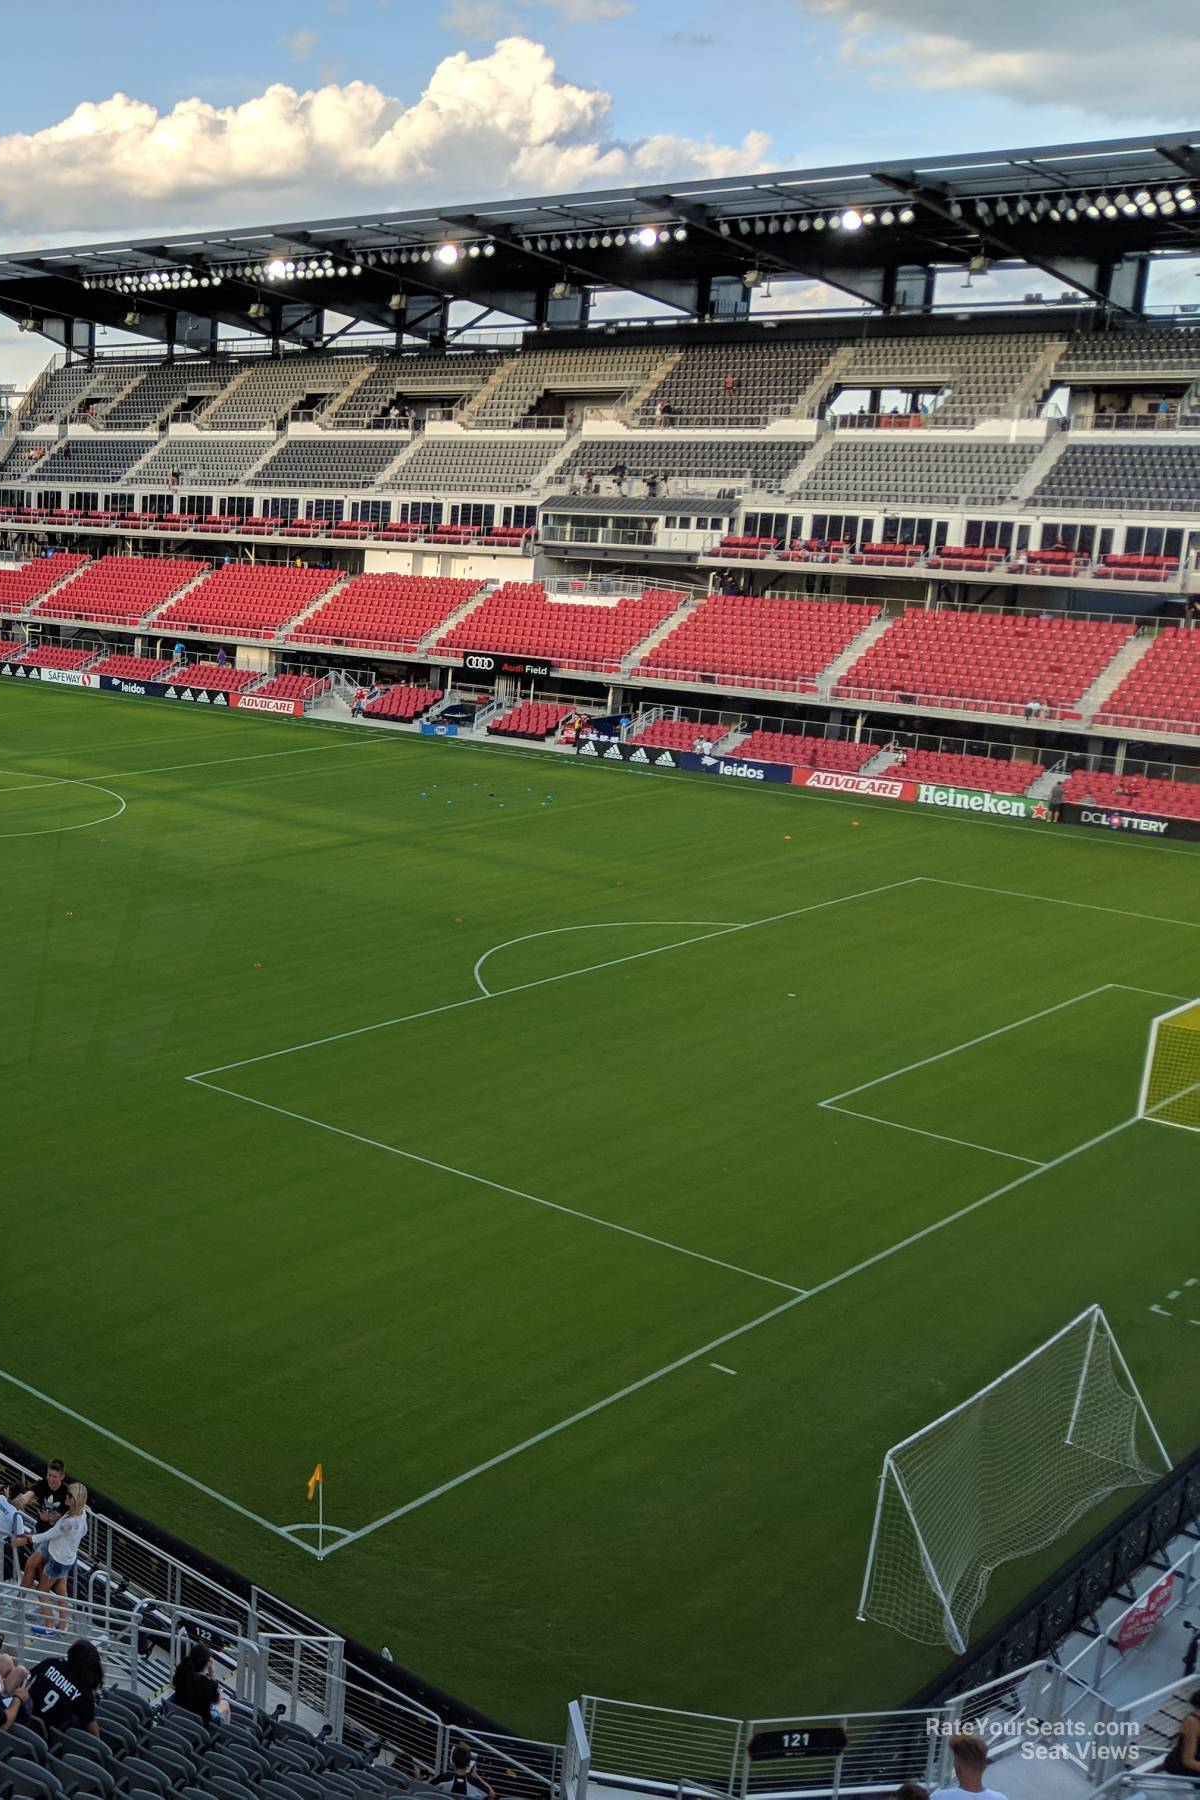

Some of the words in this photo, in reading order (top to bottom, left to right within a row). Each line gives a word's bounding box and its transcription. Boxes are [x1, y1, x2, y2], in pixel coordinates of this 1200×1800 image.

[48, 670, 82, 684] SAFEWAY
[501, 662, 524, 673] Audi
[525, 664, 548, 676] Field
[121, 682, 146, 695] leidos
[239, 697, 294, 714] ADVOCARE
[719, 761, 765, 780] leidos
[807, 772, 902, 797] ADVOCARE
[917, 784, 1026, 818] Heineken
[195, 1627, 212, 1642] 122
[44, 1665, 82, 1702] ROONEY
[40, 1690, 60, 1713] 9
[783, 1733, 810, 1748] 121
